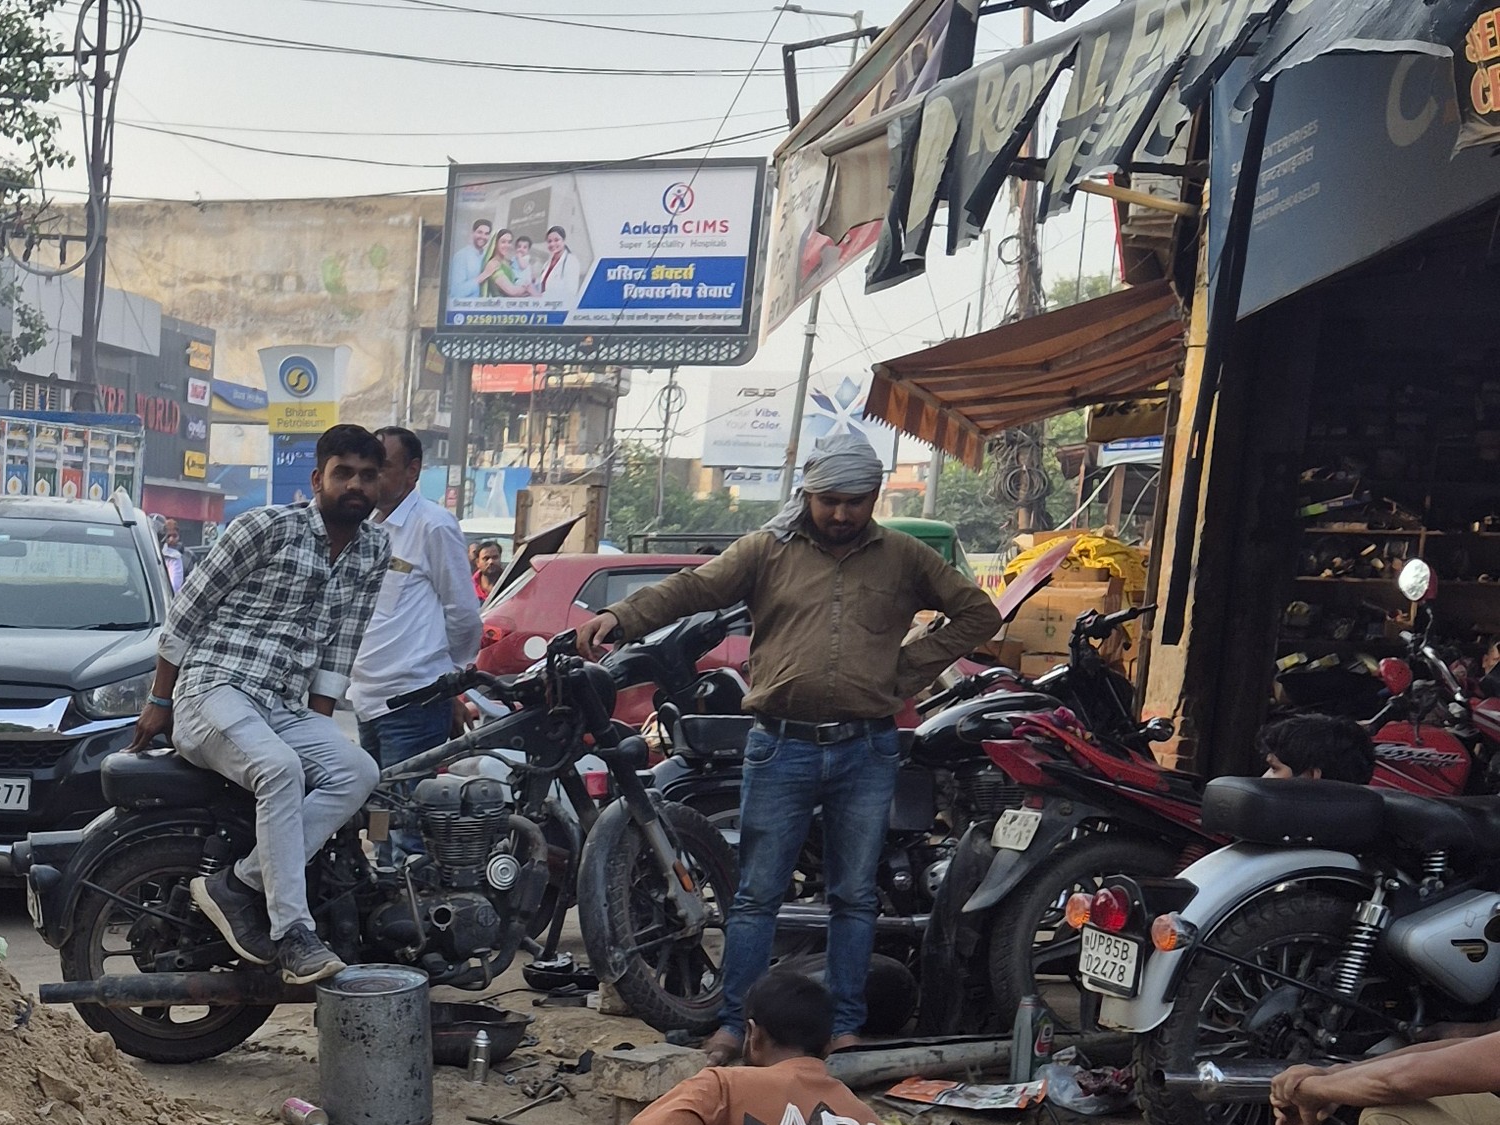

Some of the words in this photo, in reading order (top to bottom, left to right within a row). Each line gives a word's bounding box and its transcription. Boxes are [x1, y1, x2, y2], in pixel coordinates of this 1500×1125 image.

[620, 220, 678, 235] Aakash
[682, 220, 729, 233] CIMS
[619, 240, 642, 250] Super
[690, 238, 727, 248] Hospitals
[737, 387, 777, 397] ASUS
[285, 407, 318, 417] Bharat
[754, 408, 781, 418] Vibe.
[276, 418, 326, 428] Petroleum
[750, 420, 782, 430] Color.
[1089, 931, 1130, 961] UP85B
